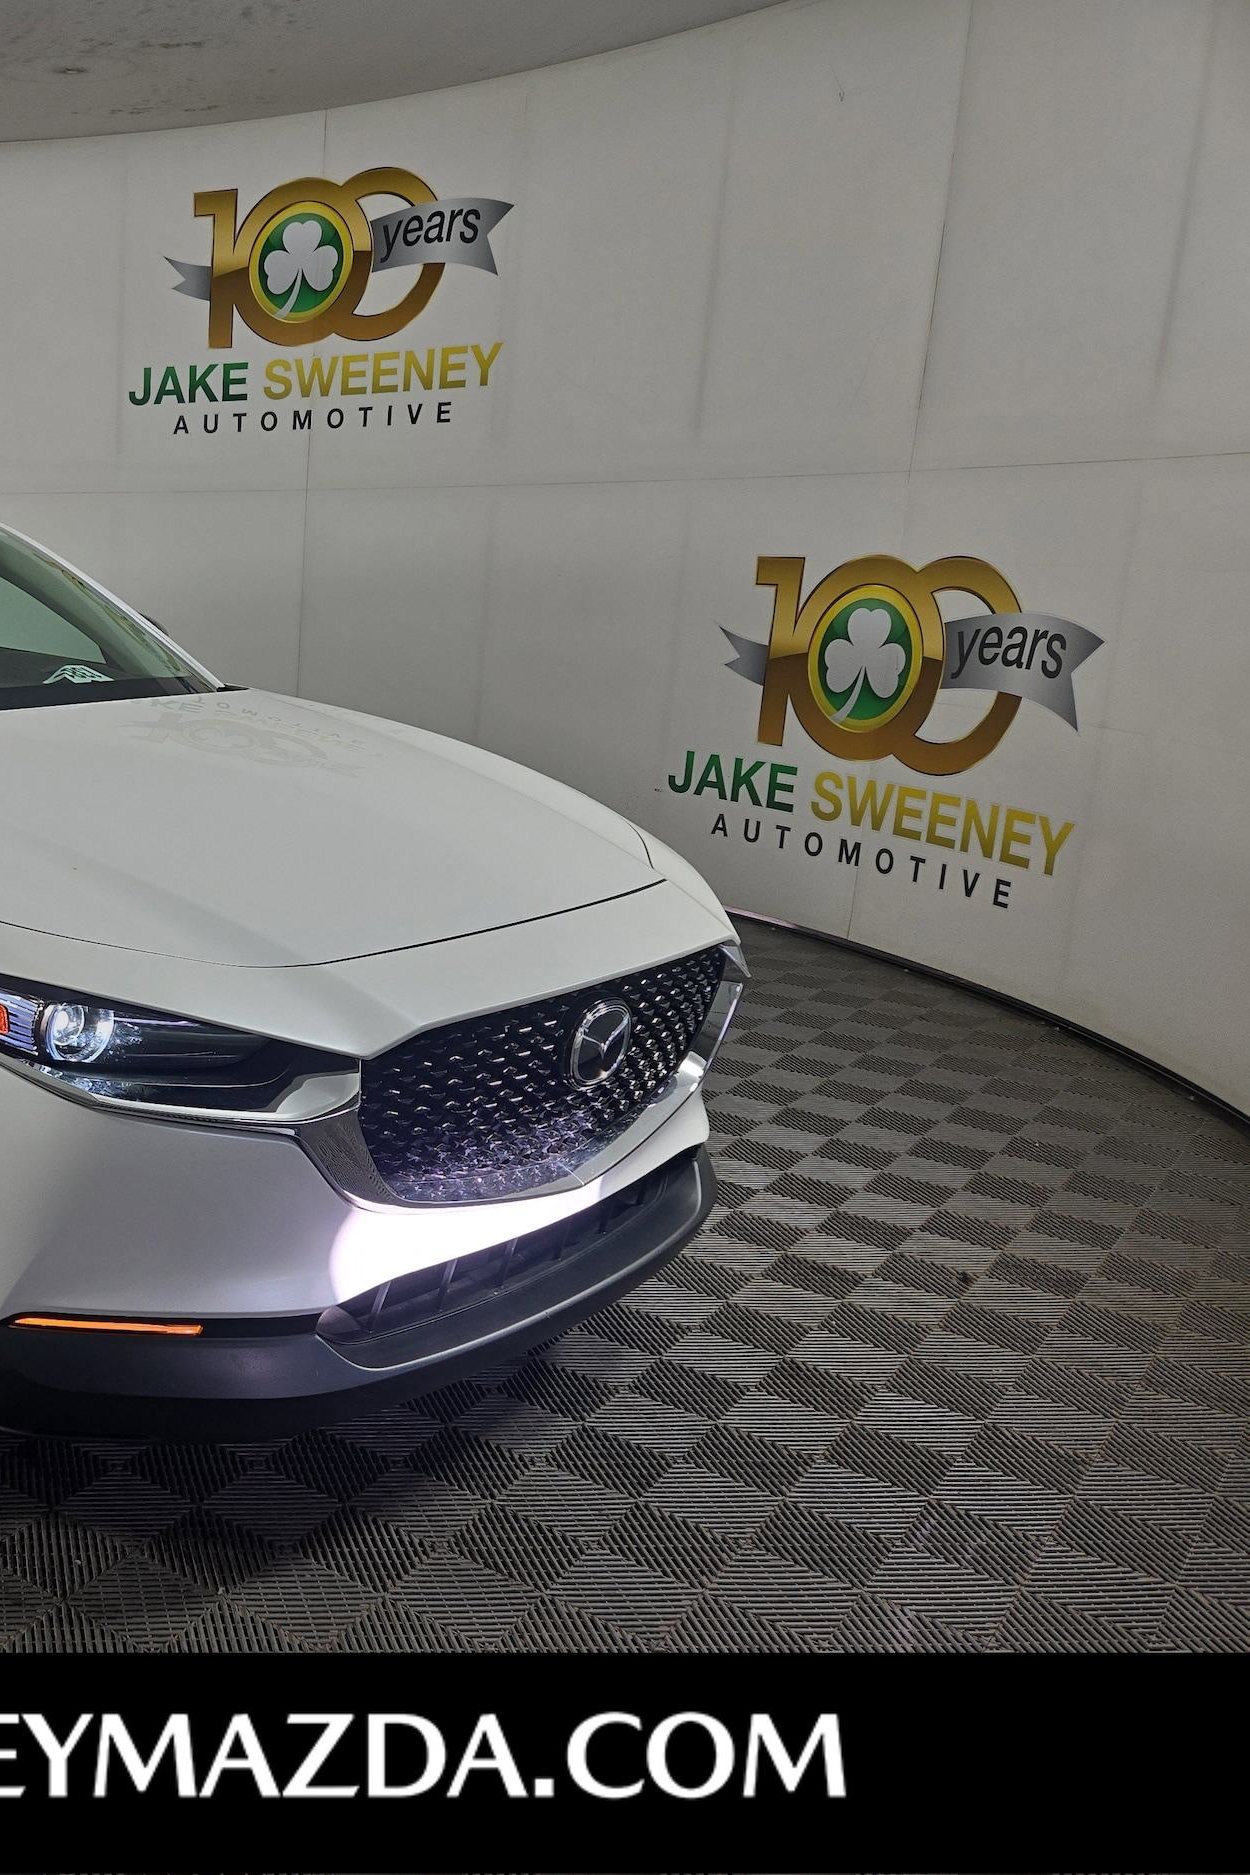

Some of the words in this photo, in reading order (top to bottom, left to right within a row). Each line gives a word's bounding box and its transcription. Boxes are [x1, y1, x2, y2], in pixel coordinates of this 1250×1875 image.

[193, 167, 447, 348] 100
[379, 207, 481, 262] years
[128, 362, 249, 406] JAKE
[263, 342, 504, 400] SWEENEY
[173, 401, 452, 435] AUTOMOTIVE
[755, 555, 1024, 776] 100
[950, 626, 1067, 679] years
[668, 750, 799, 814] JAKE
[810, 771, 1076, 877] SWEENEY
[710, 813, 1012, 910] AUTOMOTIVE
